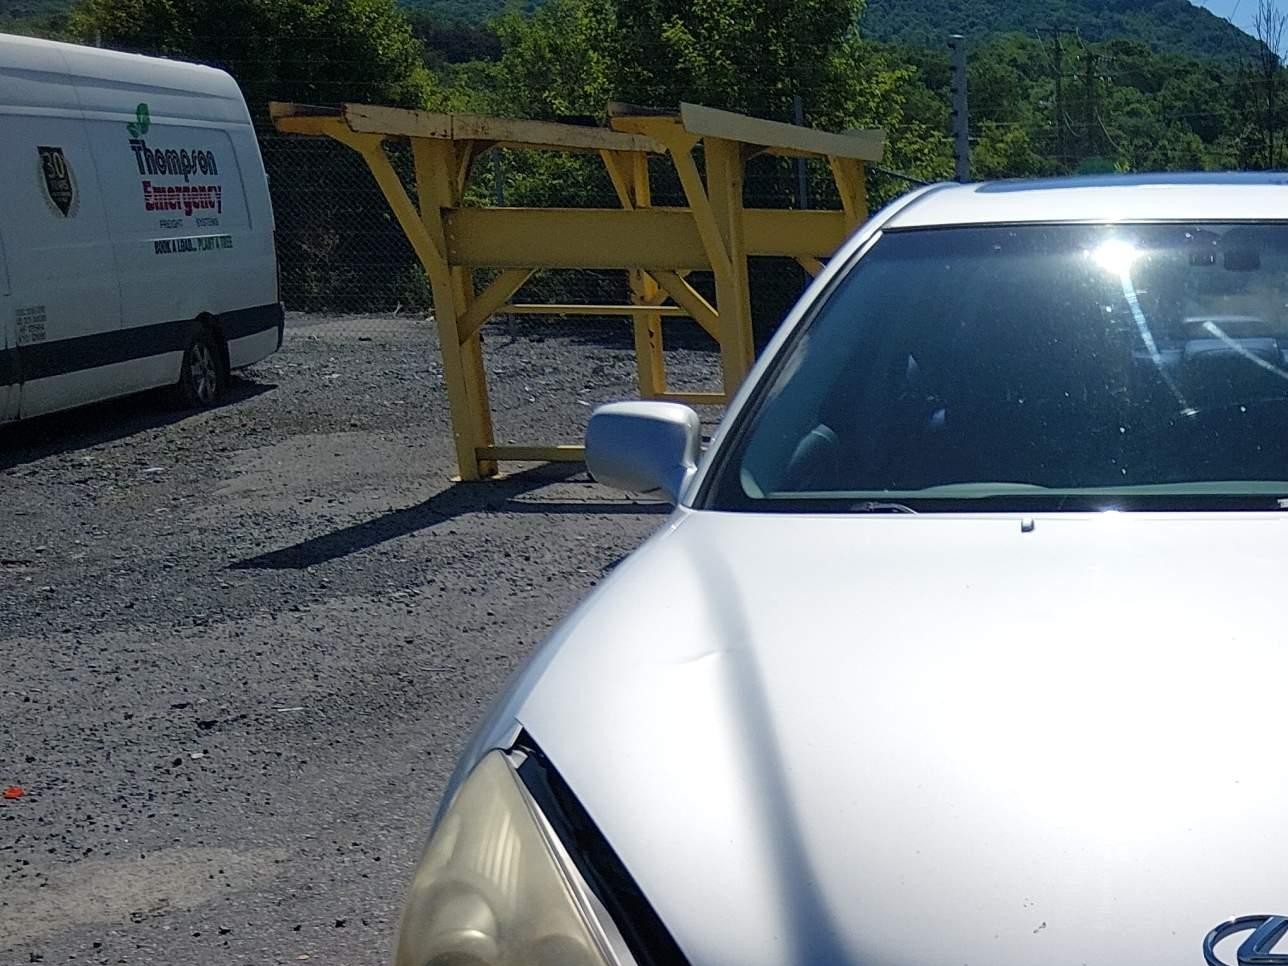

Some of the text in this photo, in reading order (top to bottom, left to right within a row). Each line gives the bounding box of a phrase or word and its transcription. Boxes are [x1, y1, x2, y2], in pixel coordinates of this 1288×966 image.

[40, 152, 65, 178] 30
[128, 139, 219, 183] Thompson
[142, 180, 222, 216] Emergency
[154, 240, 171, 254] BOOK
